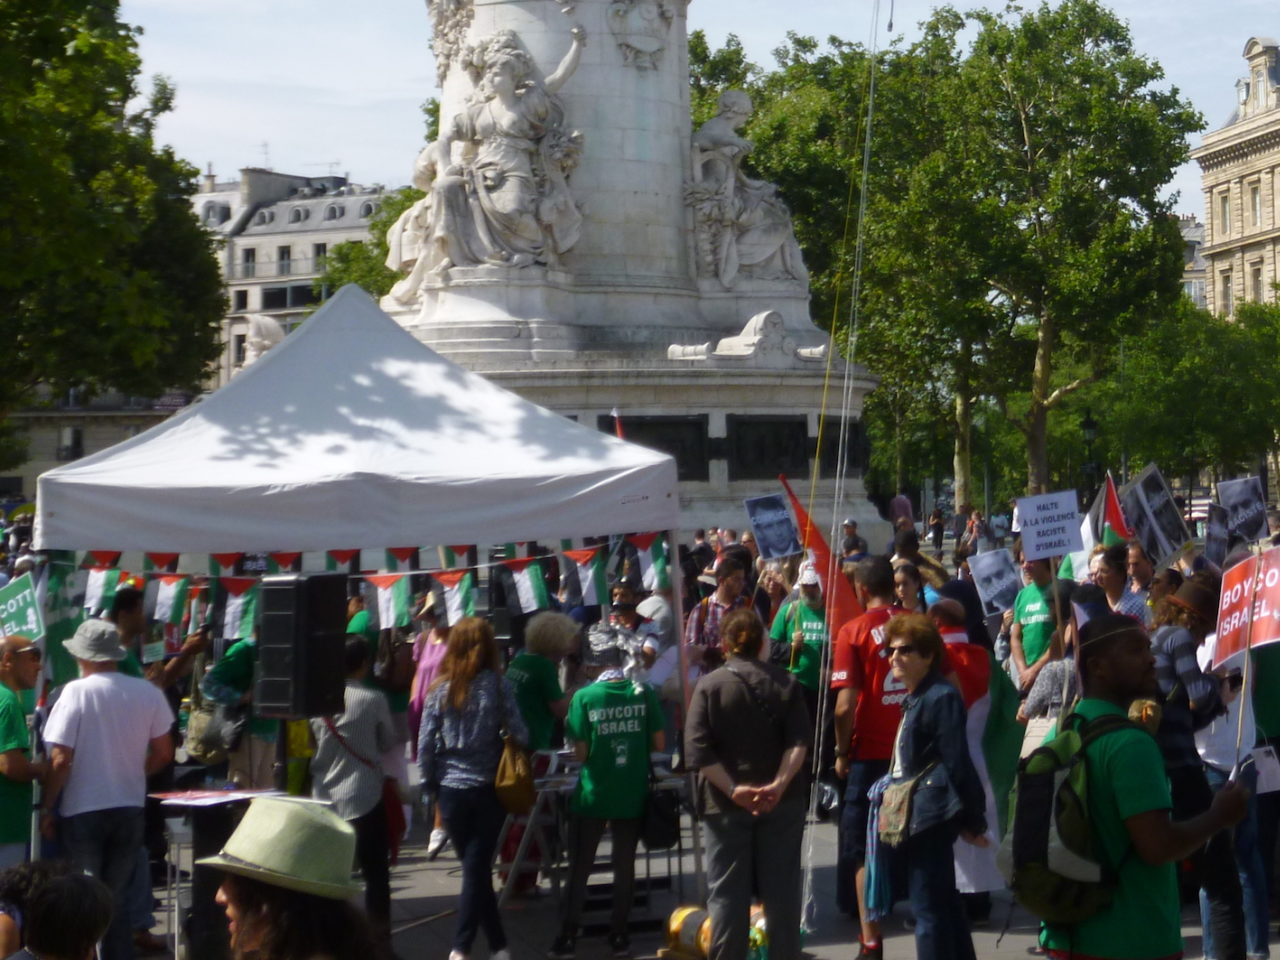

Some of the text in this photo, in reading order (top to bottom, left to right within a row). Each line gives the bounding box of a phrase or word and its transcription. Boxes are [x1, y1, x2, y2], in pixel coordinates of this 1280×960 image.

[1036, 502, 1059, 512] HALTE
[1041, 511, 1075, 524] VIOLENCE
[1036, 527, 1066, 538] RACISTE
[588, 705, 646, 722] BOYCOTT
[597, 720, 641, 735] ISRAEL
